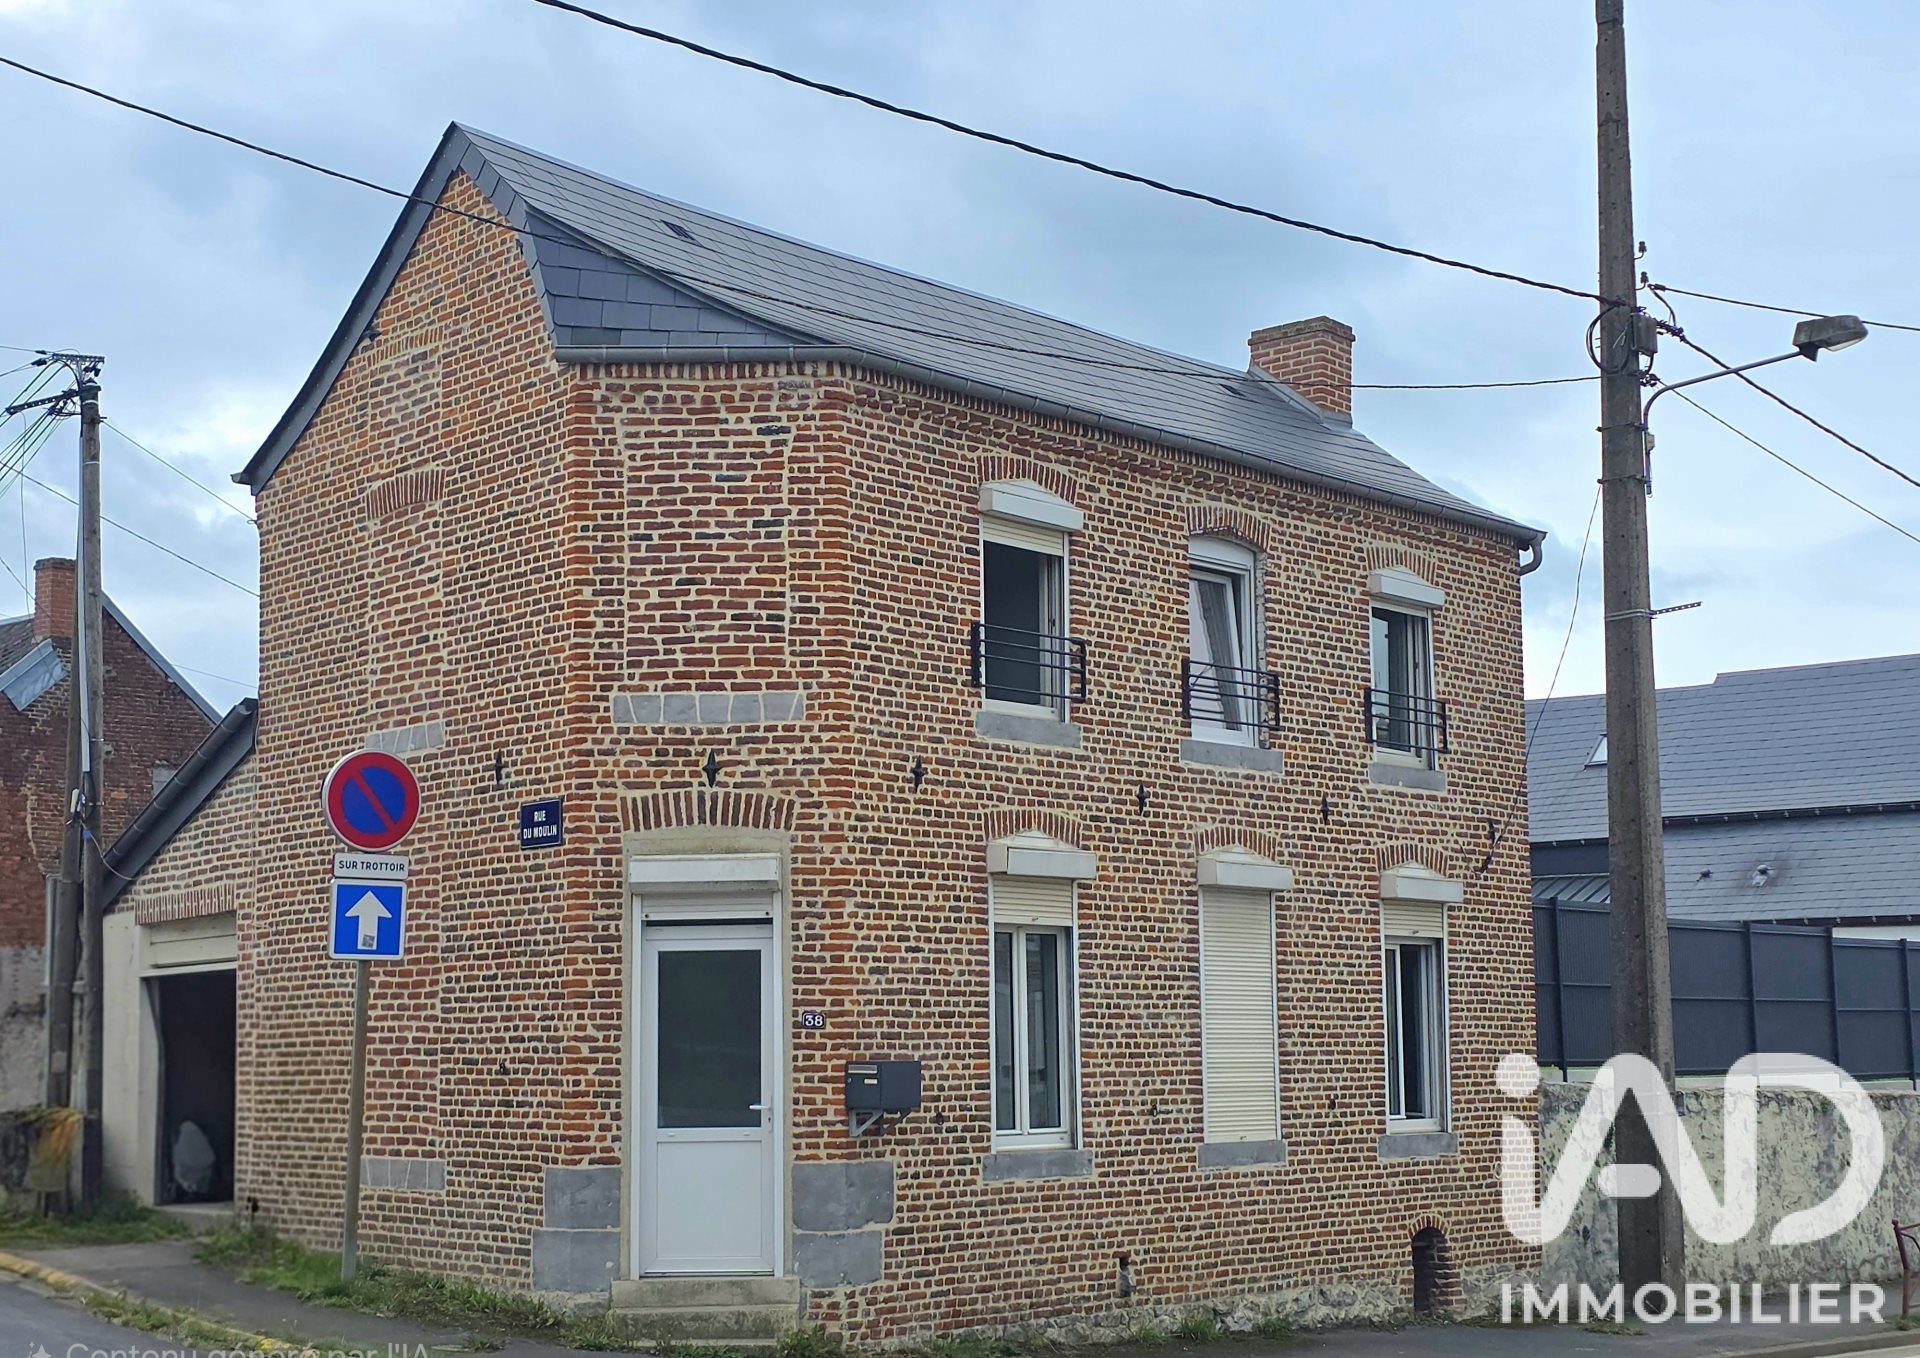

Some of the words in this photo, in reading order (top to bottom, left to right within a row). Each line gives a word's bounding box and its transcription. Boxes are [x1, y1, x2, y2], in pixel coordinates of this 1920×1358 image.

[533, 810, 547, 822] RUE
[523, 827, 532, 839] DU
[533, 824, 557, 838] MOULIN
[338, 860, 358, 870] SUR
[360, 861, 405, 872] TROTTOIR
[805, 1015, 823, 1027] 38
